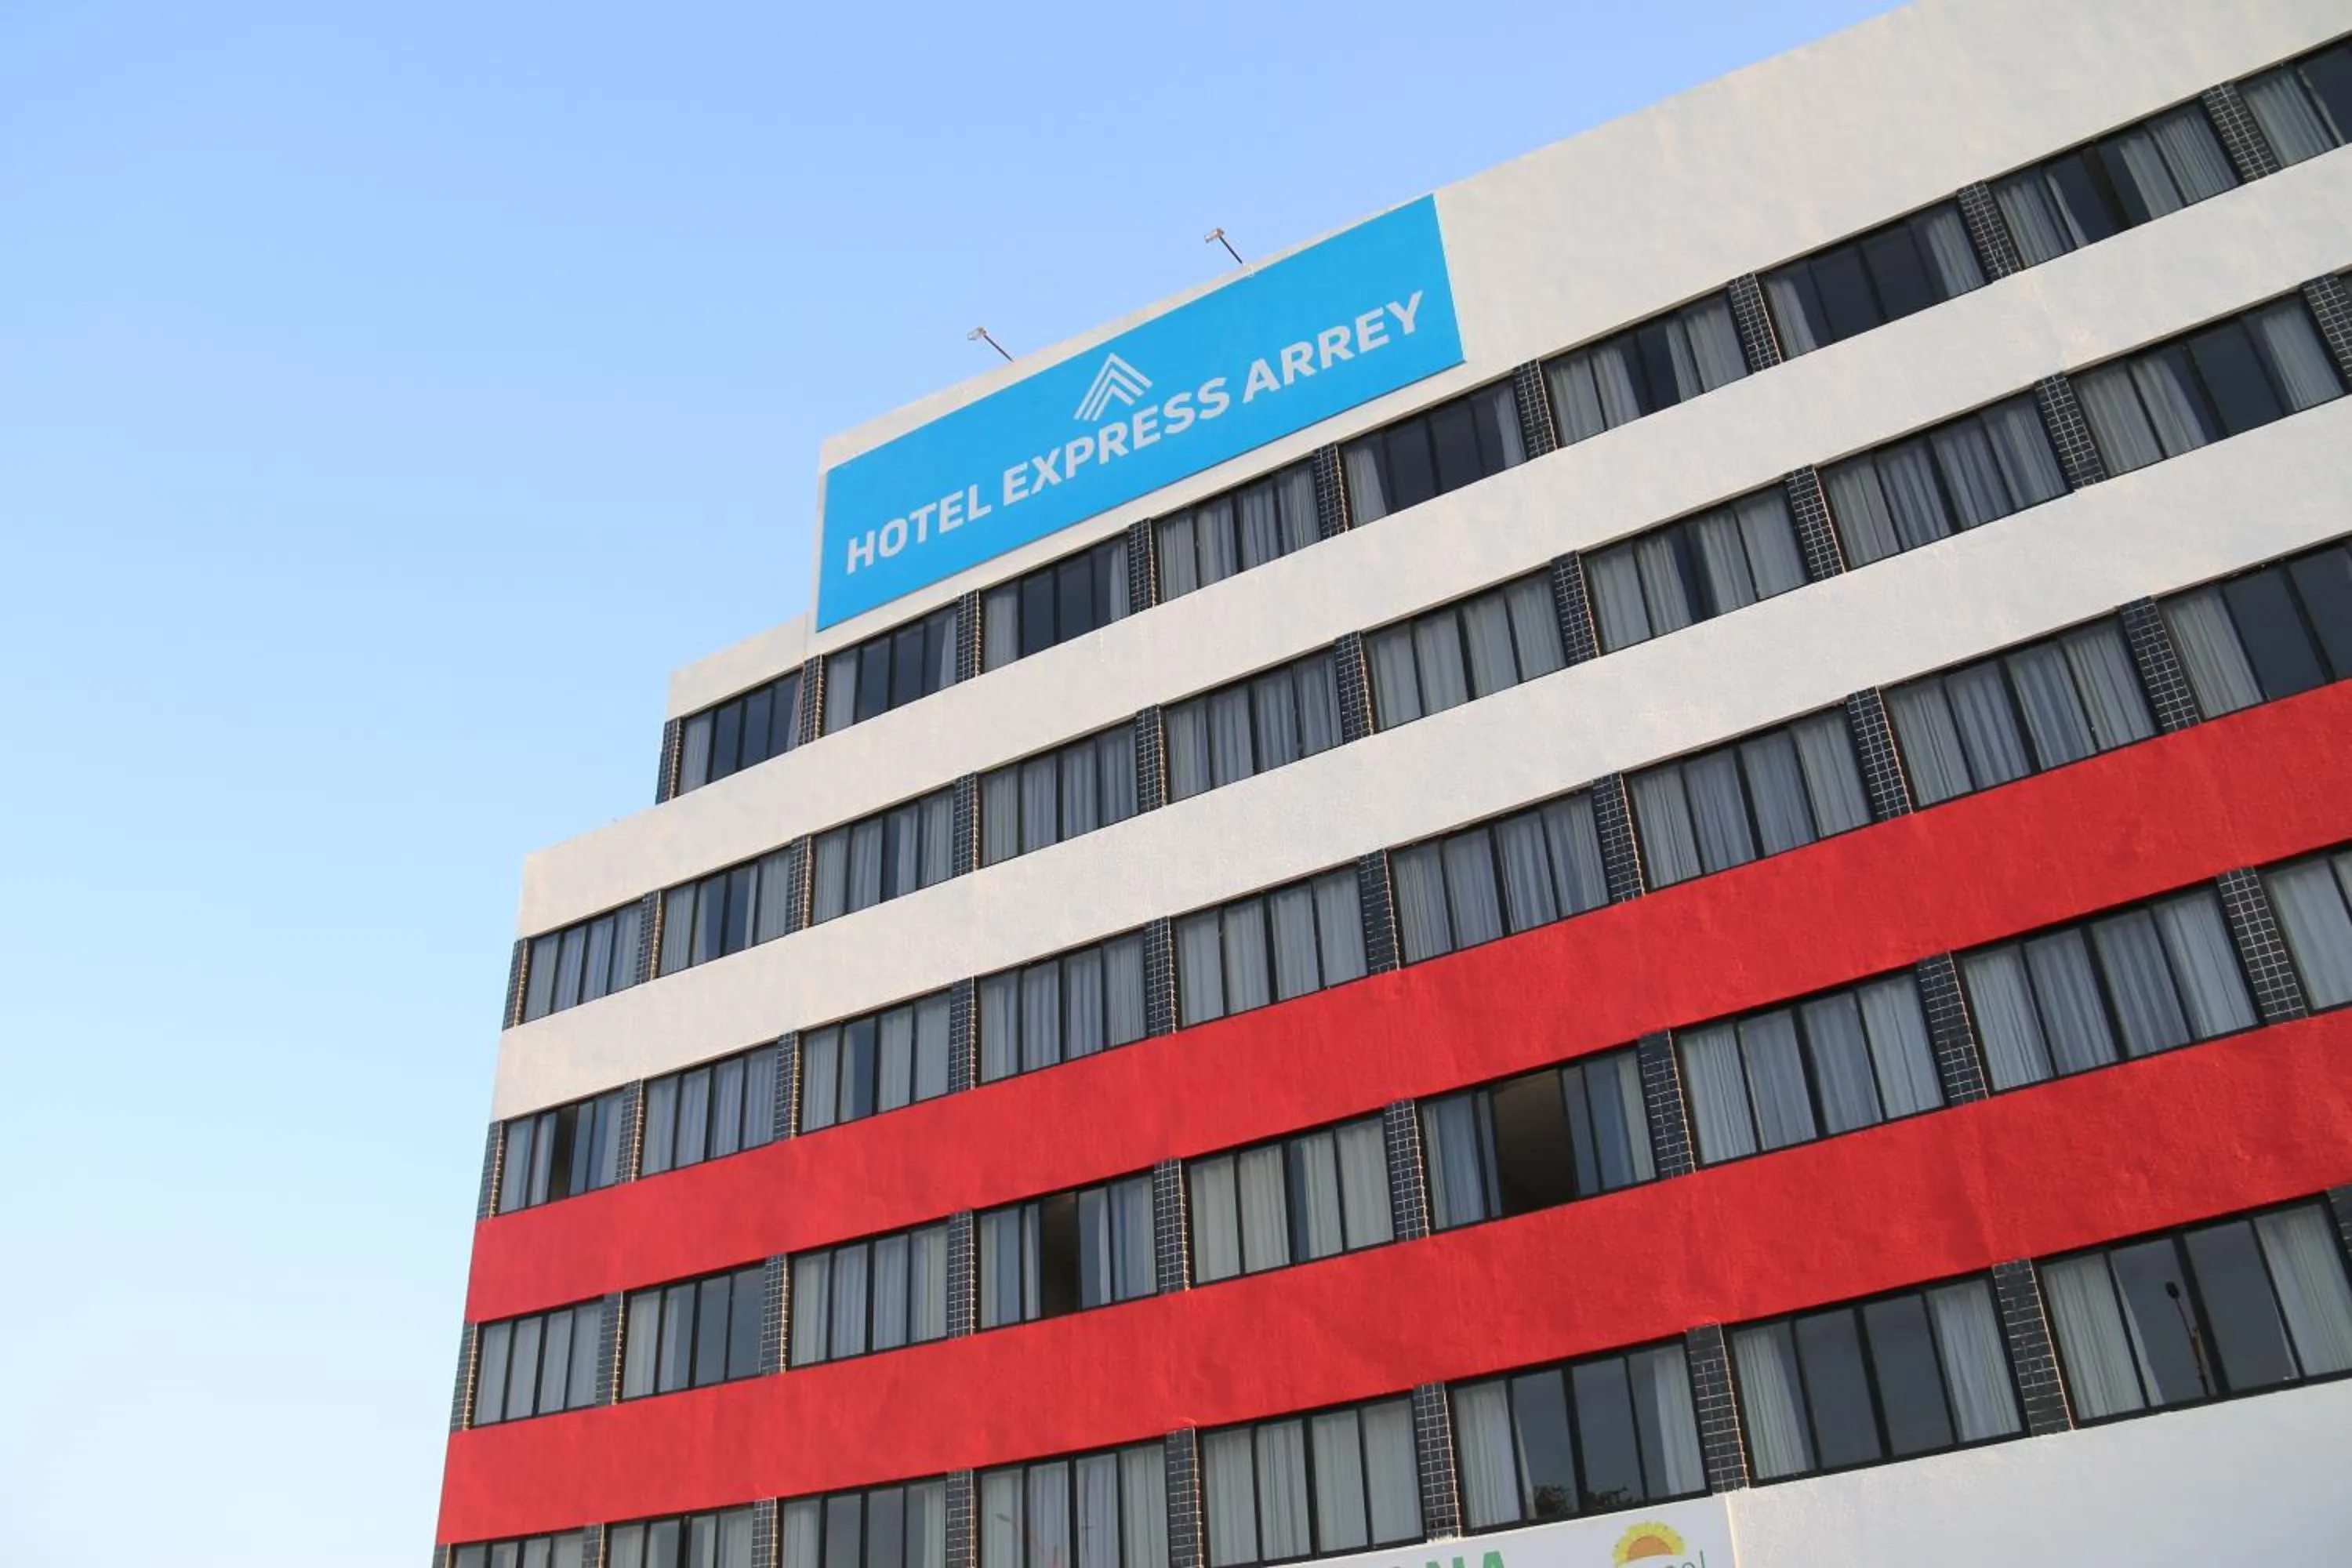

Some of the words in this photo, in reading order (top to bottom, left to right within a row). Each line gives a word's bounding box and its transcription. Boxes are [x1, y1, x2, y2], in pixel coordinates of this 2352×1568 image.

[846, 484, 992, 575] HOTEL
[1003, 376, 1230, 506] EXPRESS
[1243, 291, 1423, 403] ARREY
